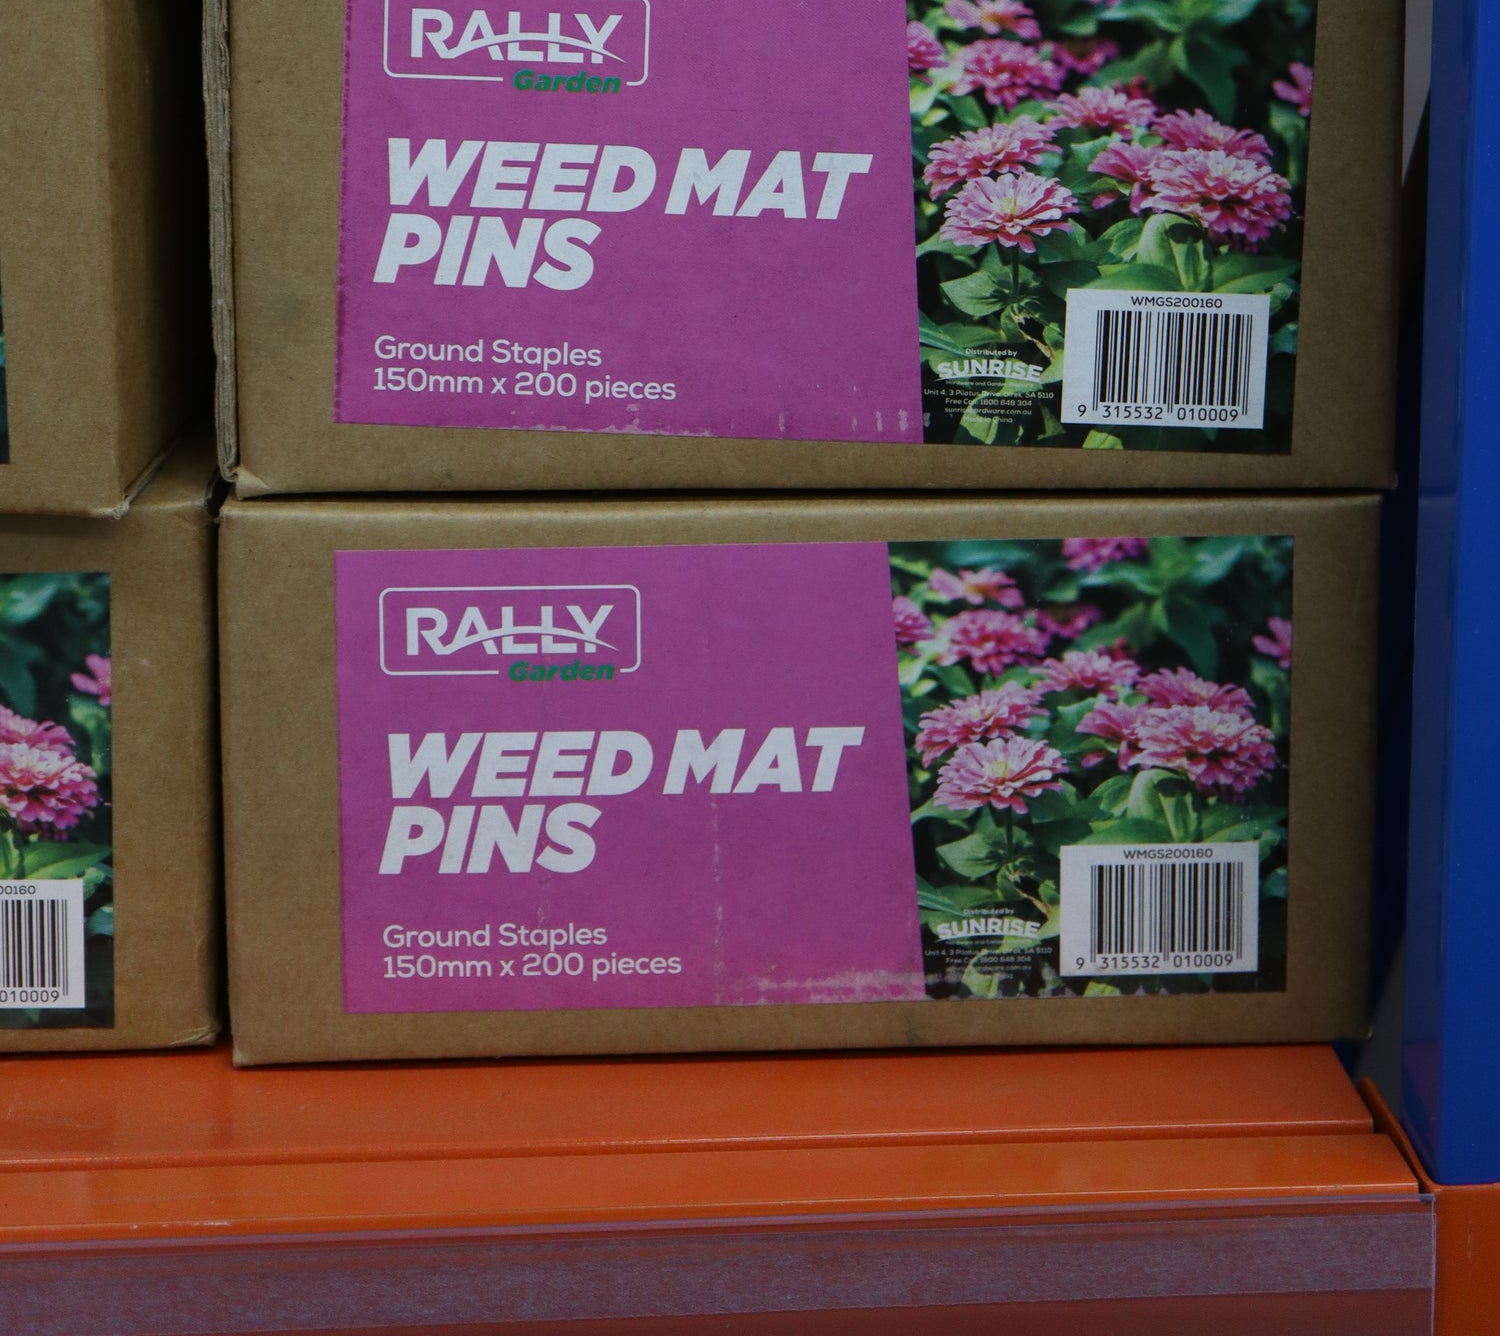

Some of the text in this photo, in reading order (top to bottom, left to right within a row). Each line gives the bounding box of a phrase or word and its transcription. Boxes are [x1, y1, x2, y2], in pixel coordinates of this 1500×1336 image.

[410, 7, 628, 64] RALLY
[513, 70, 622, 94] Garden
[388, 137, 873, 220] WEED MAT
[372, 213, 602, 291] PINS
[1130, 295, 1223, 309] WMGS200160
[374, 335, 602, 370] Ground Staples
[1008, 349, 1018, 357] by
[936, 359, 1043, 383] SUNRISE
[373, 367, 677, 404] 150mm x 200 pieces
[1037, 391, 1054, 399] 5110
[1077, 404, 1239, 422] 9 315532 010009
[406, 605, 619, 656] RALLY
[508, 659, 615, 682] Garden
[388, 726, 865, 799] WEED MAT
[378, 802, 602, 875] PINS
[1123, 848, 1213, 859] WMGS200160
[963, 908, 1015, 916] Distributed by
[383, 922, 607, 952] Ground Staples
[936, 918, 1041, 941] SUNRISE
[383, 952, 682, 982] 150mm x 200 pieces
[1076, 953, 1233, 970] 9 315532 010009
